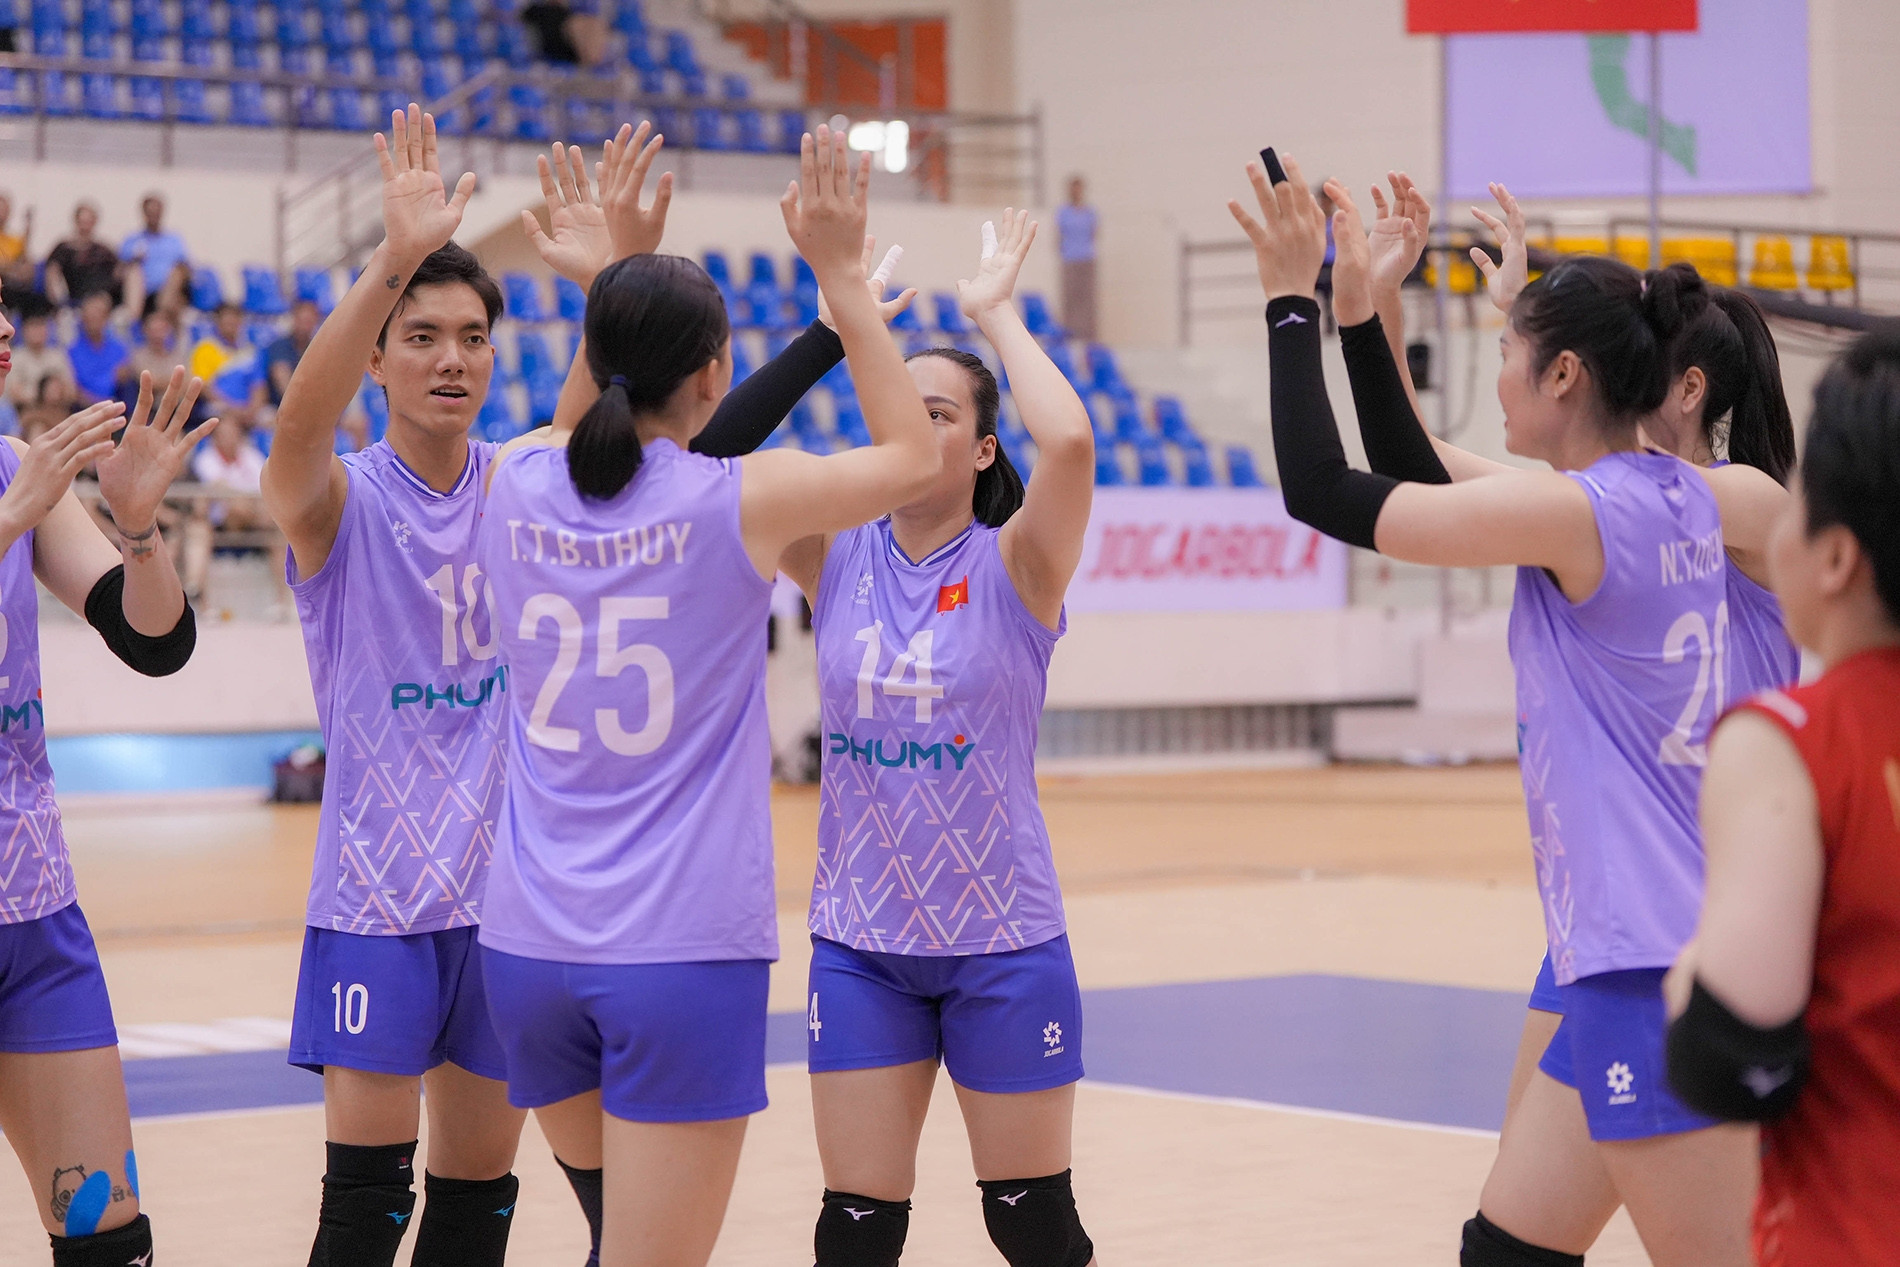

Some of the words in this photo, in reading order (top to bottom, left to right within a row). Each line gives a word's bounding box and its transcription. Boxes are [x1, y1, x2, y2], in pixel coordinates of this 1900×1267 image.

[424, 562, 500, 666] 10
[391, 664, 510, 710] PHUM
[518, 592, 675, 757] 25
[854, 618, 944, 724] 14
[829, 732, 976, 771] PHUMY
[331, 981, 369, 1035] 10
